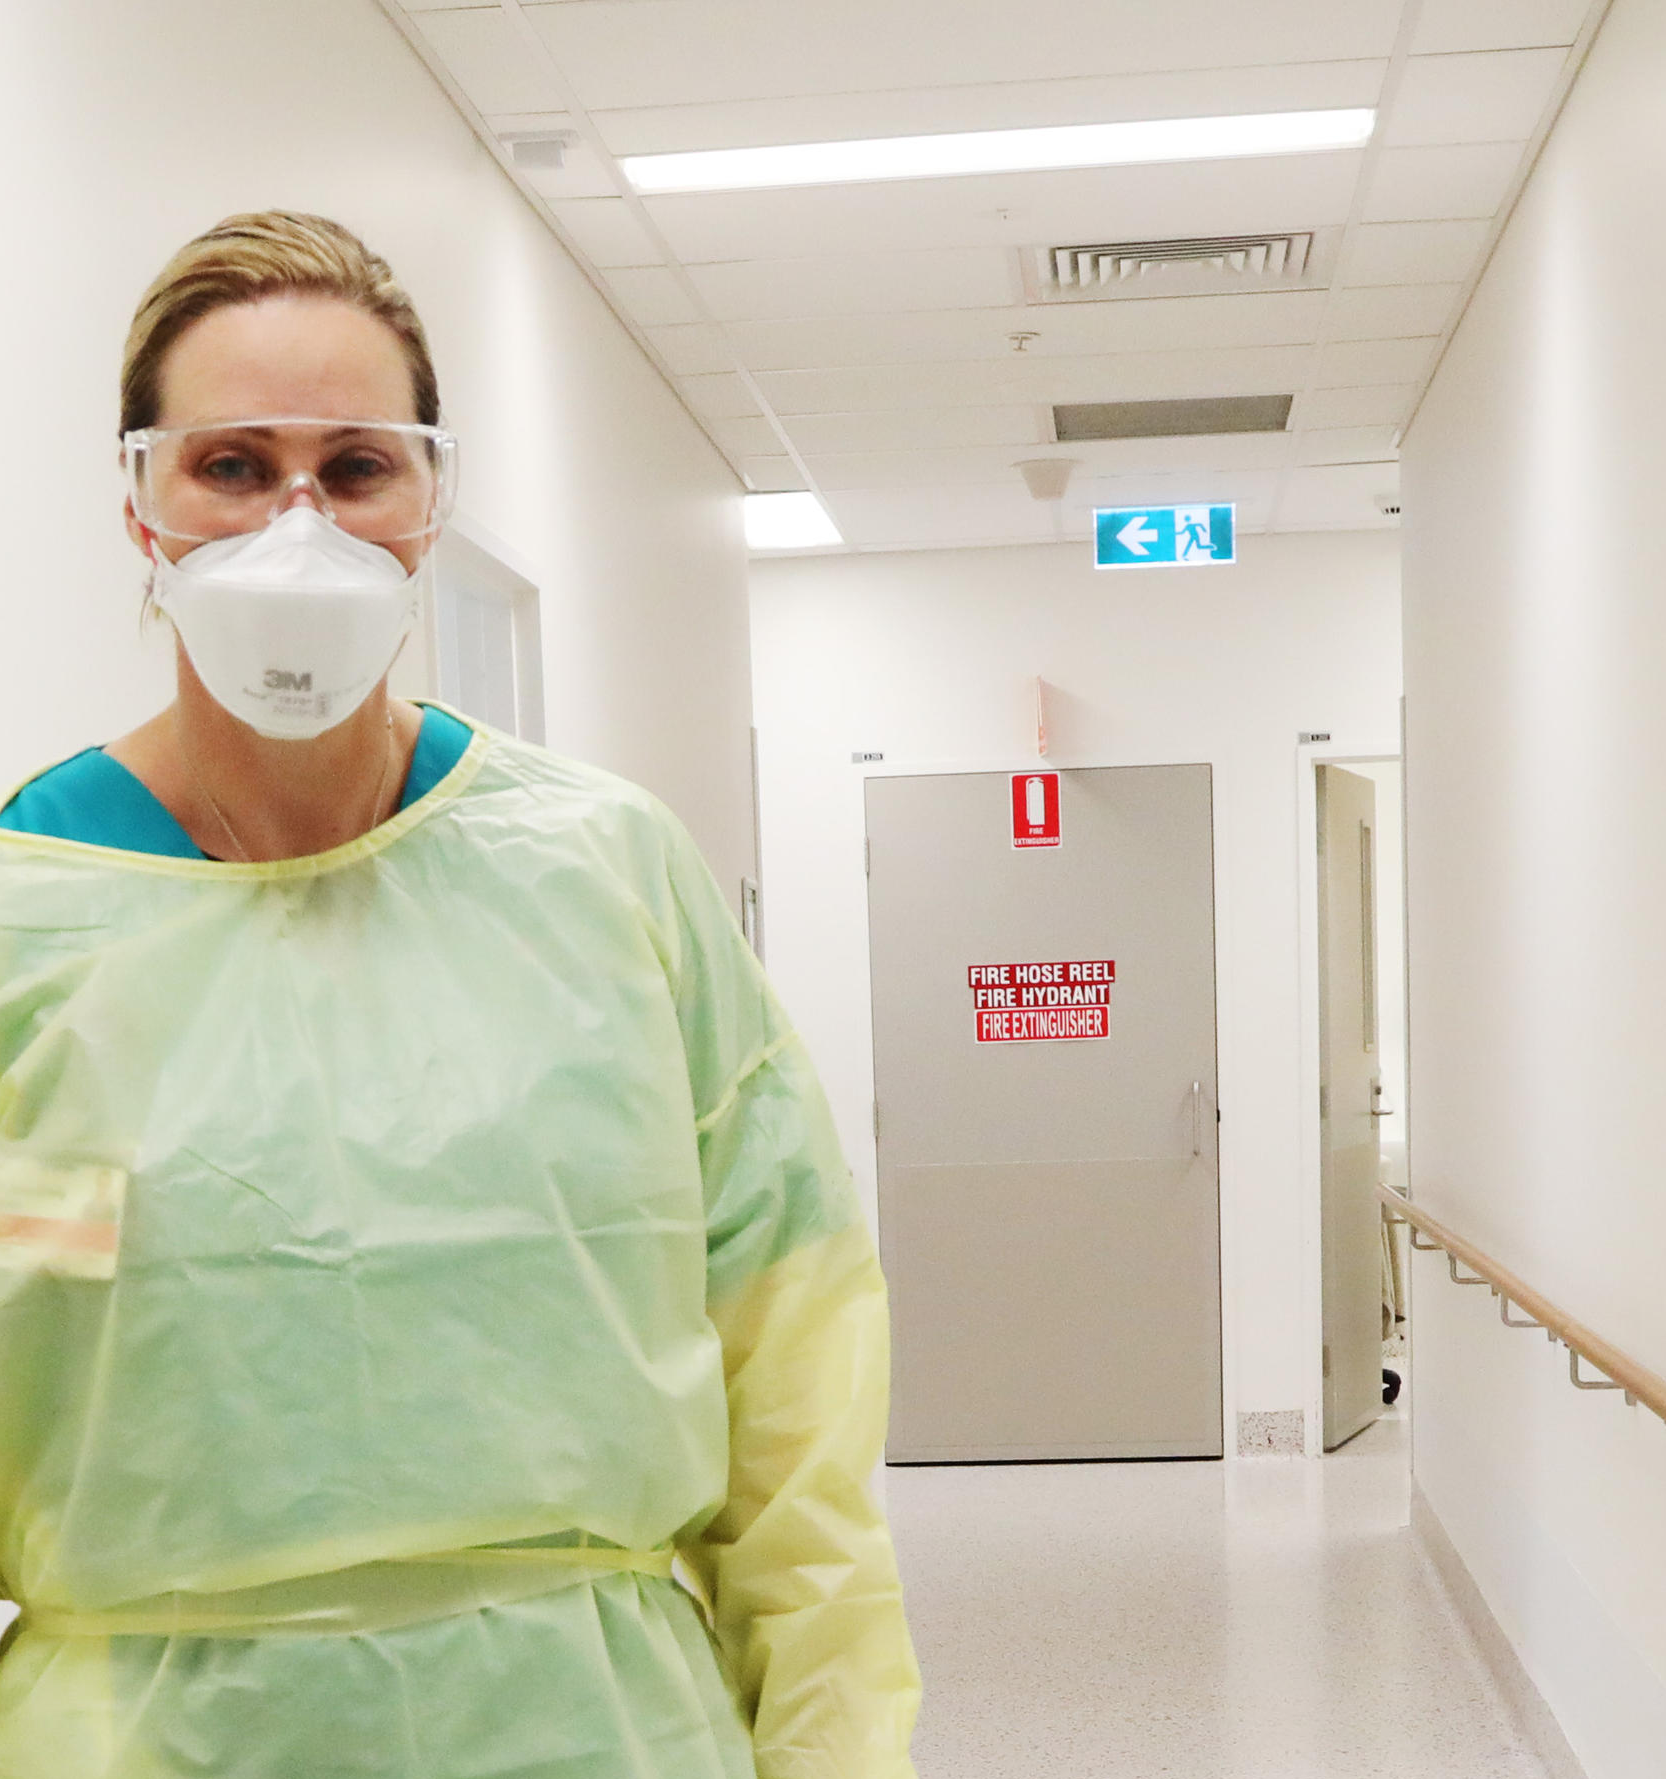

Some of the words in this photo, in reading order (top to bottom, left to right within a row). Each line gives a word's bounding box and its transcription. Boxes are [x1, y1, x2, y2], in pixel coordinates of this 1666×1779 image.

[263, 669, 312, 692] 3M
[970, 967, 1011, 986] FIRE
[1015, 964, 1064, 984] HOSE
[1069, 963, 1114, 982] REEL
[976, 988, 1017, 1008] FIRE
[1022, 985, 1108, 1006] HYDRANT
[982, 1012, 1011, 1040] FIRE
[1012, 1009, 1103, 1038] EXTINGUISHER
